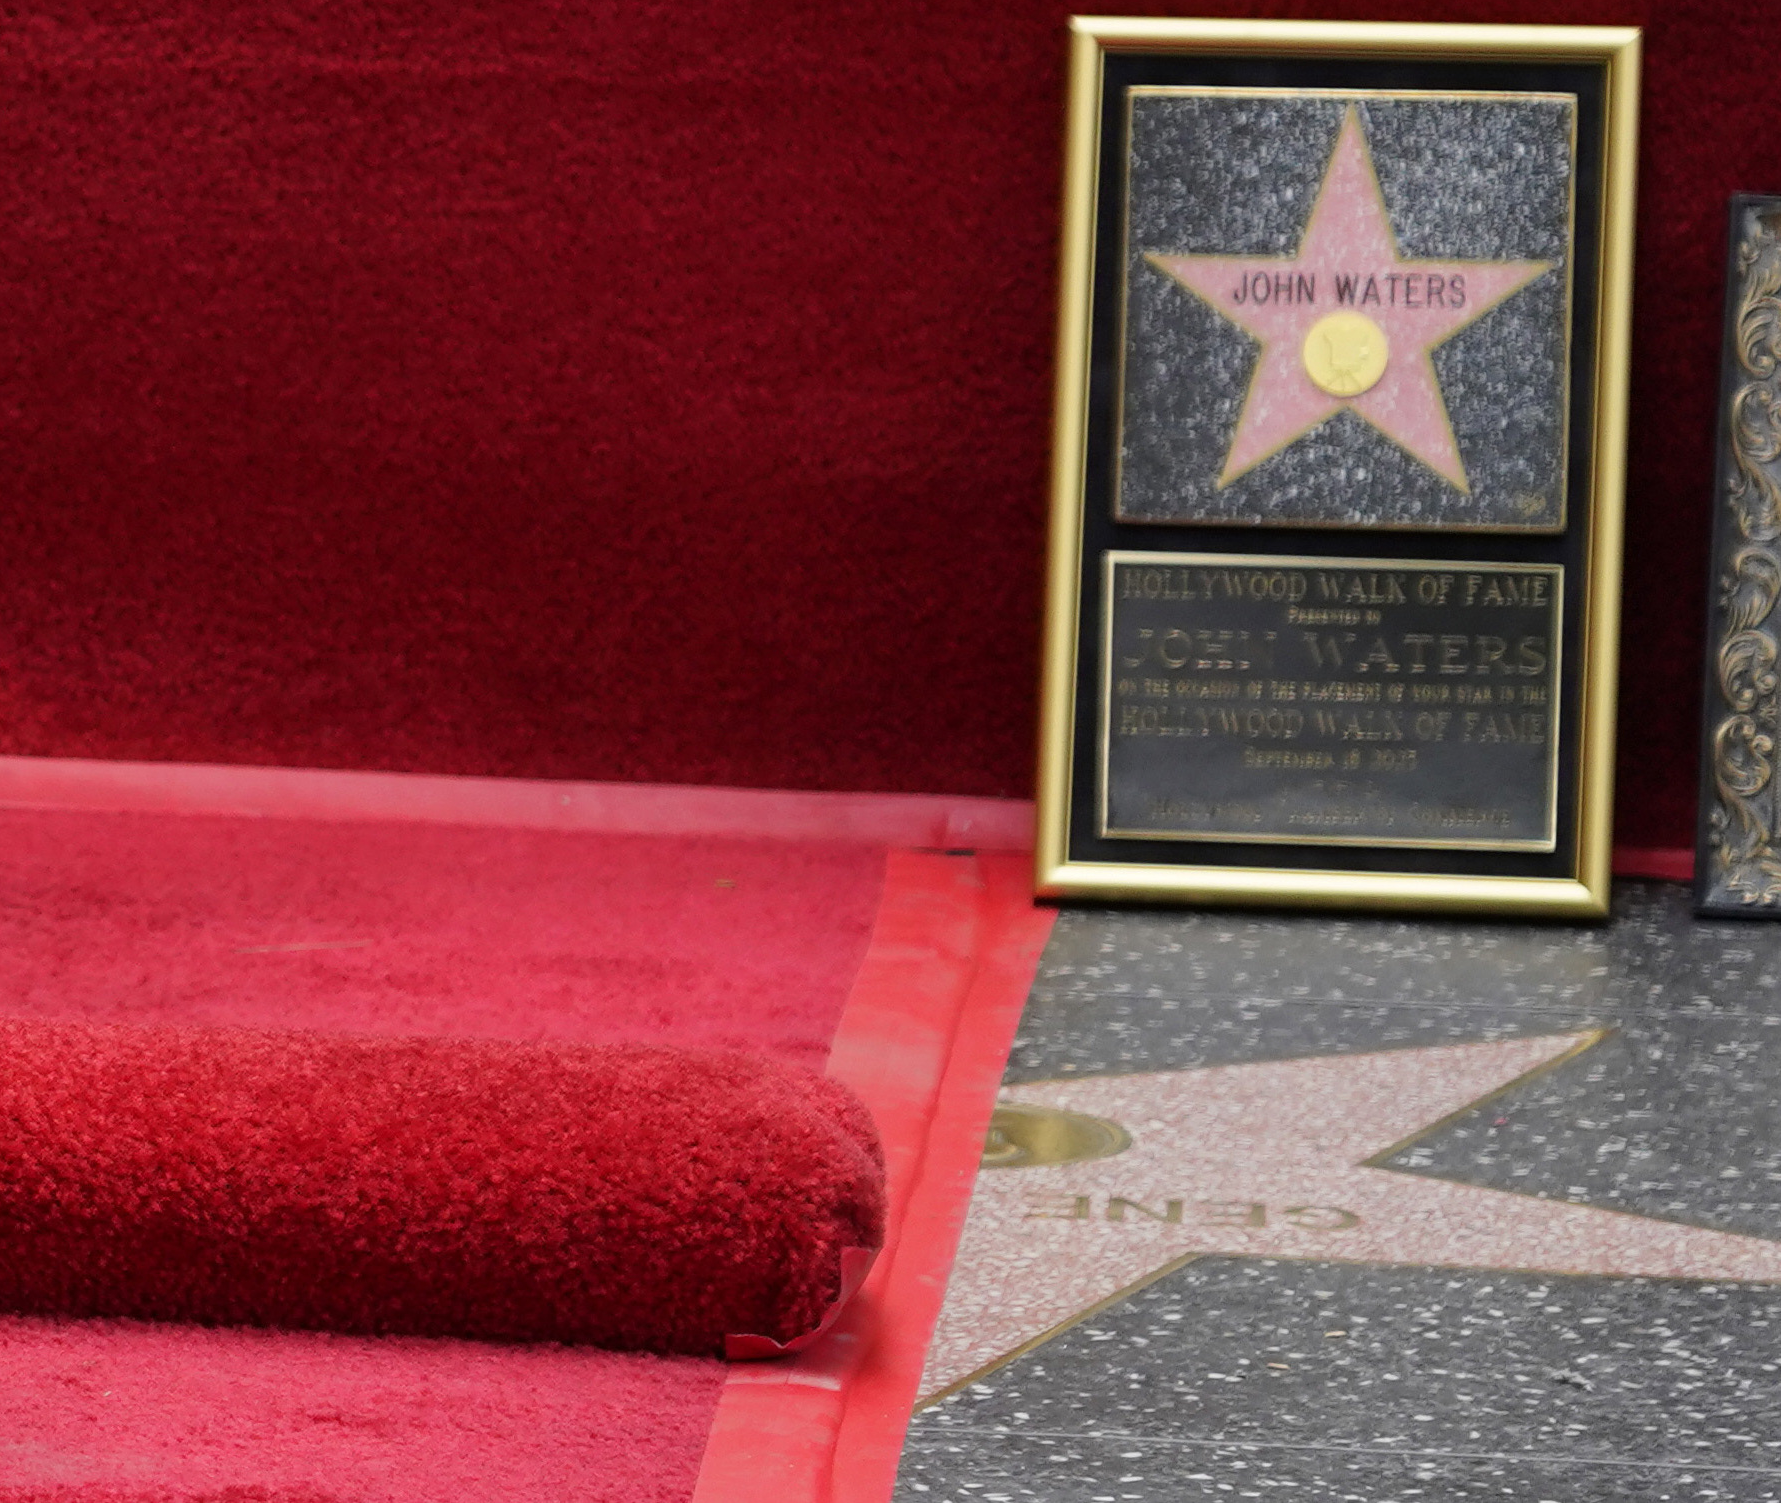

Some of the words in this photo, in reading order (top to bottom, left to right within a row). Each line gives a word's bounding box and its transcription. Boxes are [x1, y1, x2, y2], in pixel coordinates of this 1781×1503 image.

[1233, 270, 1316, 306] JOHN
[1334, 272, 1467, 309] WATERS
[1122, 567, 1307, 601] HOLLYWOOD
[1318, 571, 1405, 603] WALK
[1417, 573, 1455, 605] OF
[1465, 574, 1548, 608] FAME
[1121, 627, 1279, 671] JOHN
[1301, 630, 1548, 677] WATERS
[1120, 704, 1305, 739] HOLLYWOOD
[1415, 710, 1453, 743] OF
[1022, 1193, 1361, 1231] GENE
